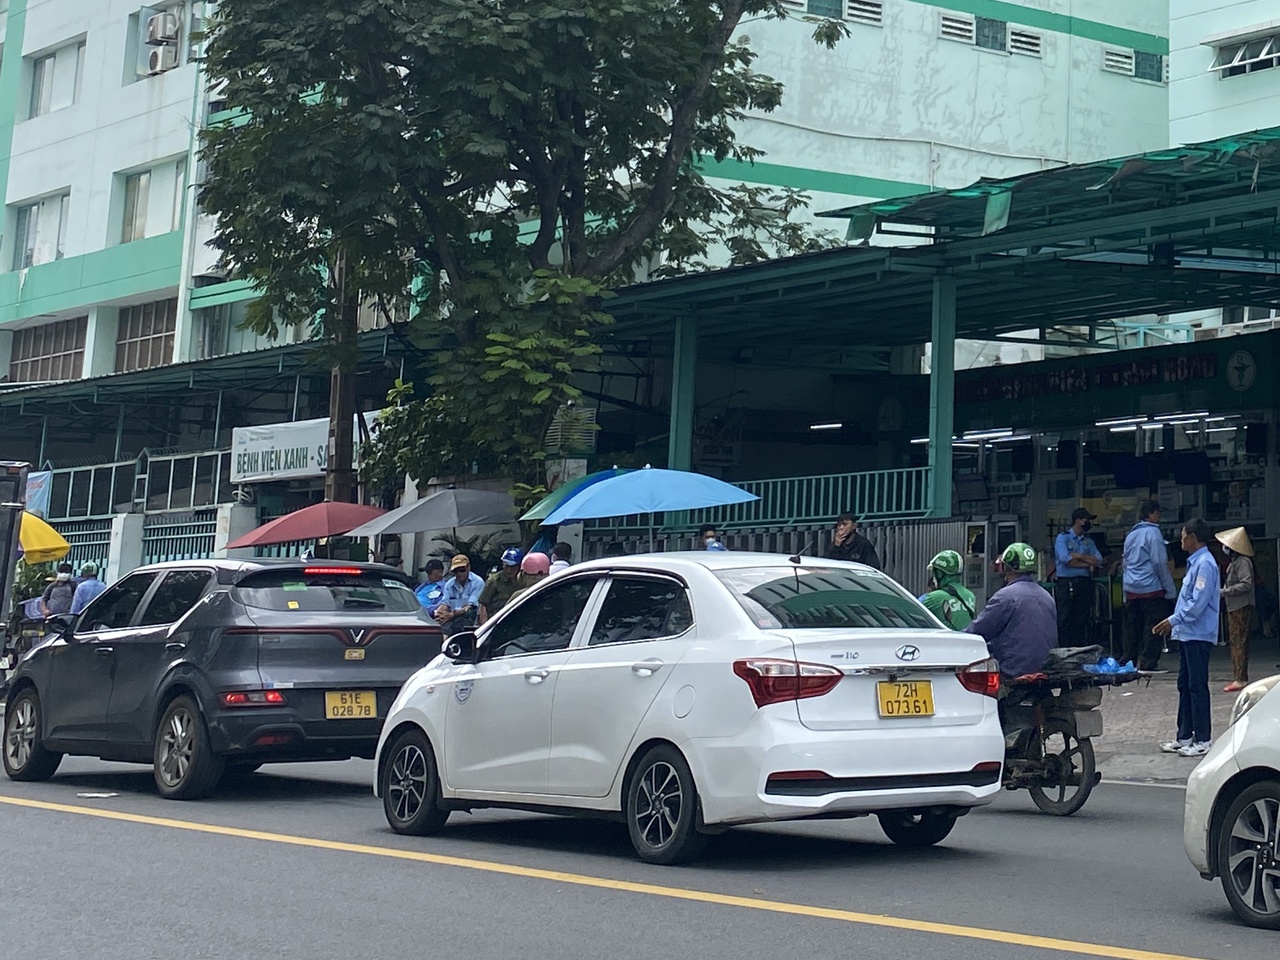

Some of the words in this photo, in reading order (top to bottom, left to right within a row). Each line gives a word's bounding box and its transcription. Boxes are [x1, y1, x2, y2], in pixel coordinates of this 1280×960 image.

[237, 448, 259, 478] BỆNH
[261, 446, 281, 476] VIỆN
[283, 446, 309, 470] XANH
[340, 692, 361, 705] 61E
[893, 683, 918, 699] 72H
[332, 705, 371, 717] 028.78
[886, 699, 929, 715] 073.61
